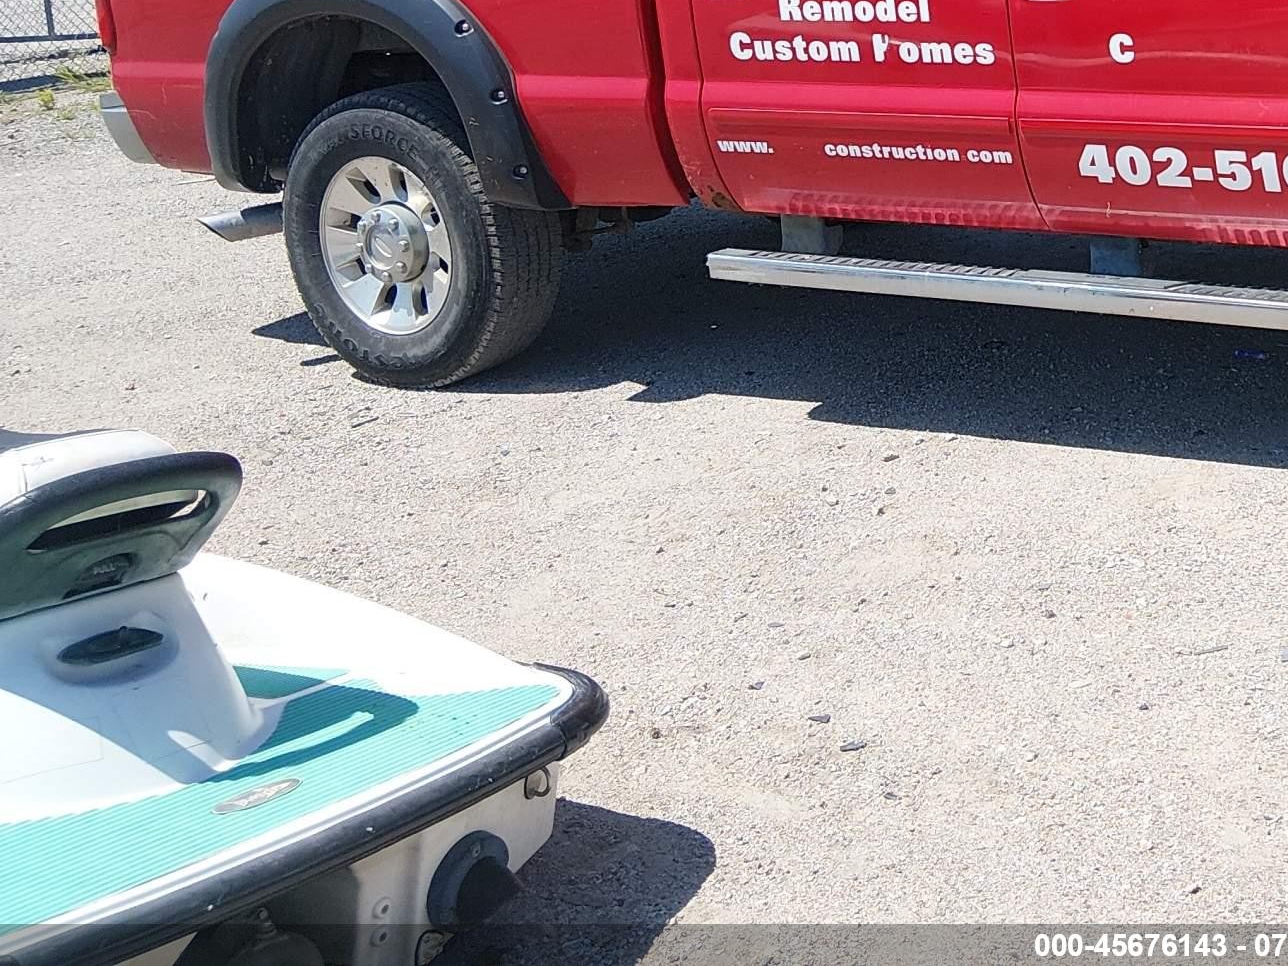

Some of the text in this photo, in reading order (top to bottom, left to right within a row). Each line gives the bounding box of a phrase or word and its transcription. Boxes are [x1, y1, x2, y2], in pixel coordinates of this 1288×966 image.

[729, 31, 861, 64] Custom
[717, 139, 1013, 165] www. construction com
